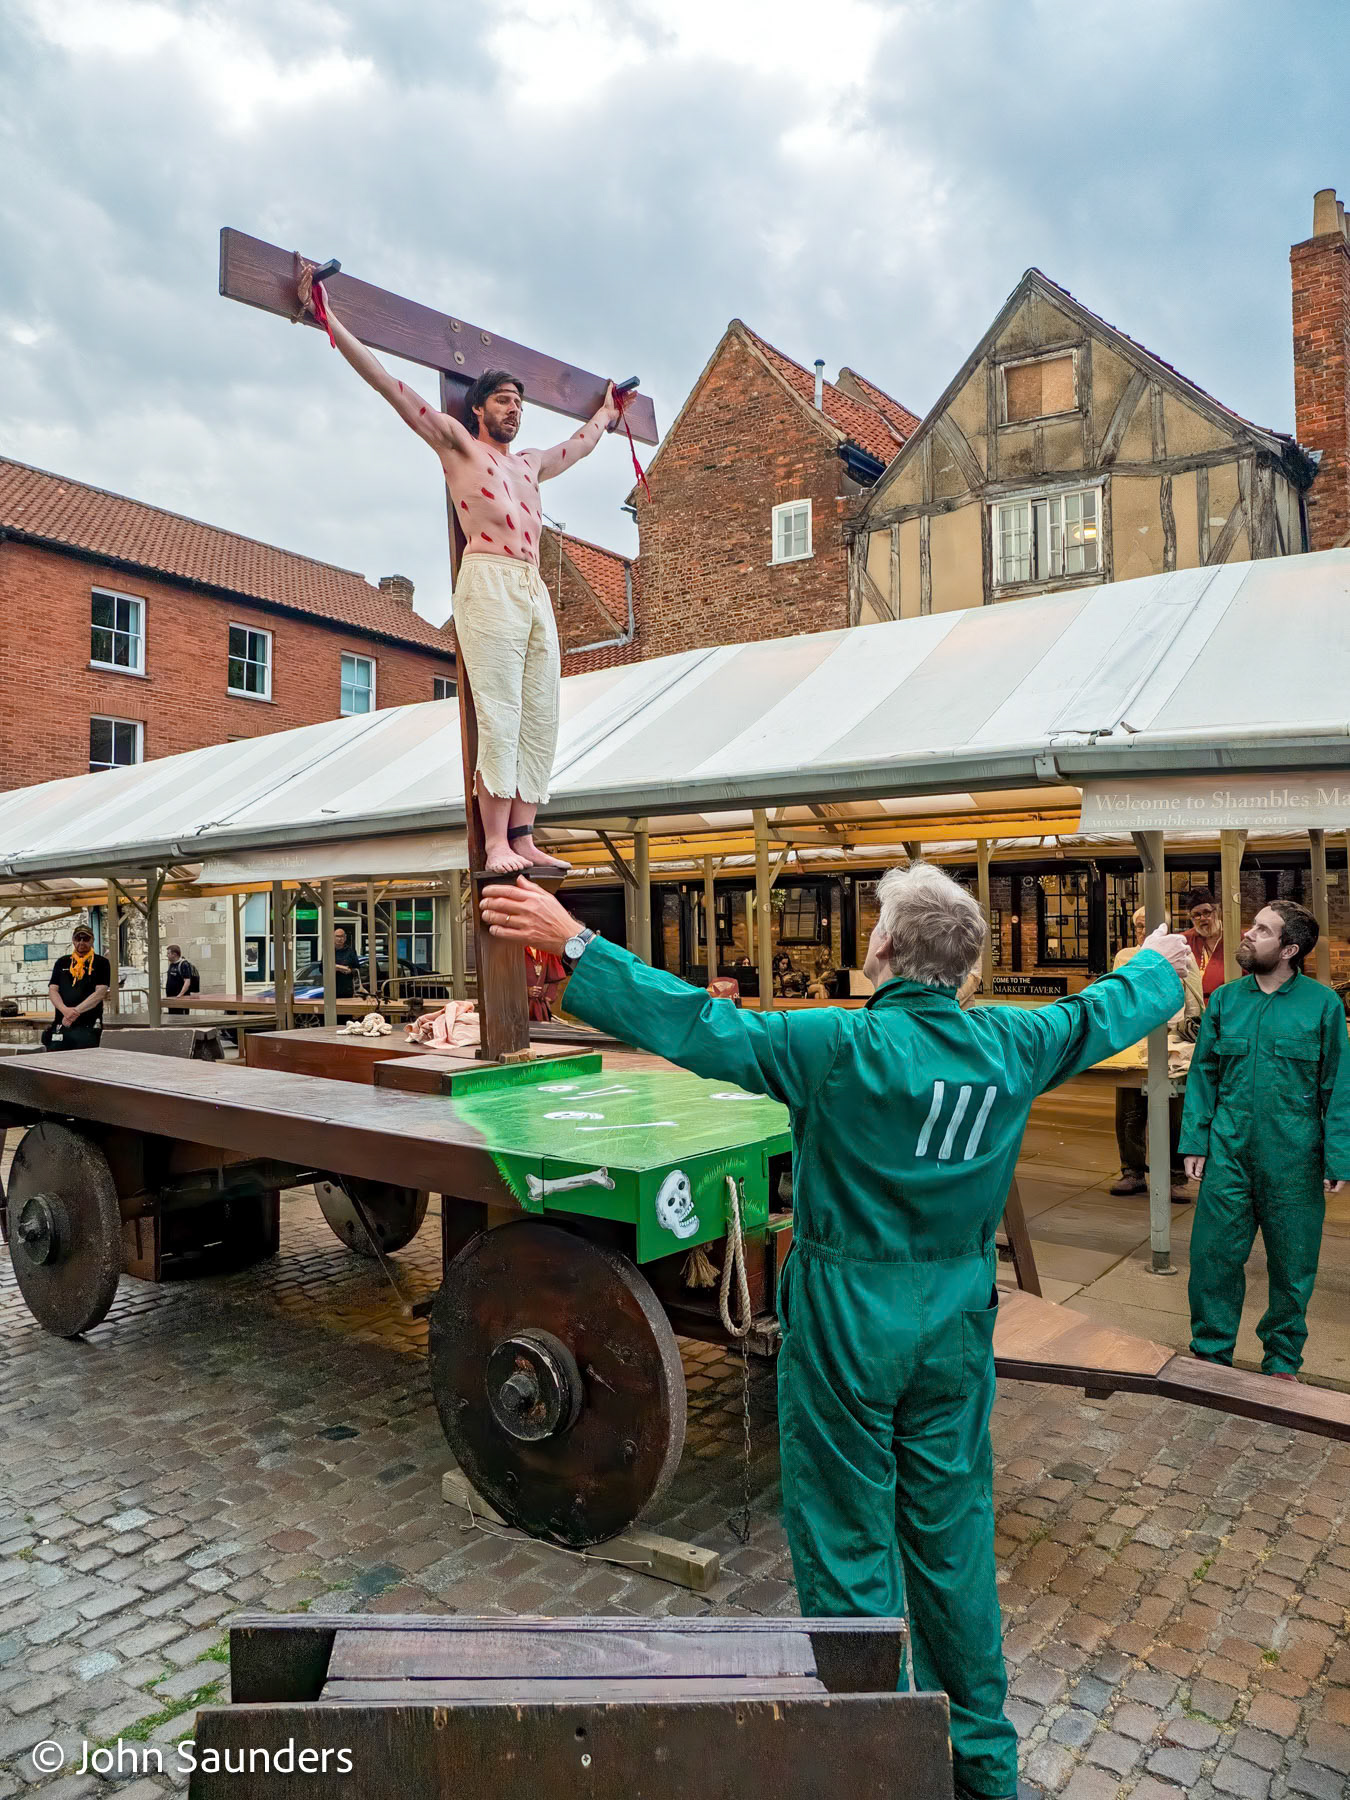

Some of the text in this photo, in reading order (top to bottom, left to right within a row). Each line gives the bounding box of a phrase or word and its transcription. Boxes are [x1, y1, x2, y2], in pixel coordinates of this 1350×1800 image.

[1095, 793, 1181, 811] Welcome
[1187, 796, 1206, 809] to
[1211, 790, 1310, 809] Shambles
[1092, 813, 1288, 829] www.shamblesmarket.com
[992, 976, 1009, 984] COME
[994, 985, 1027, 994] MARKET
[1029, 985, 1061, 994] TAVERN
